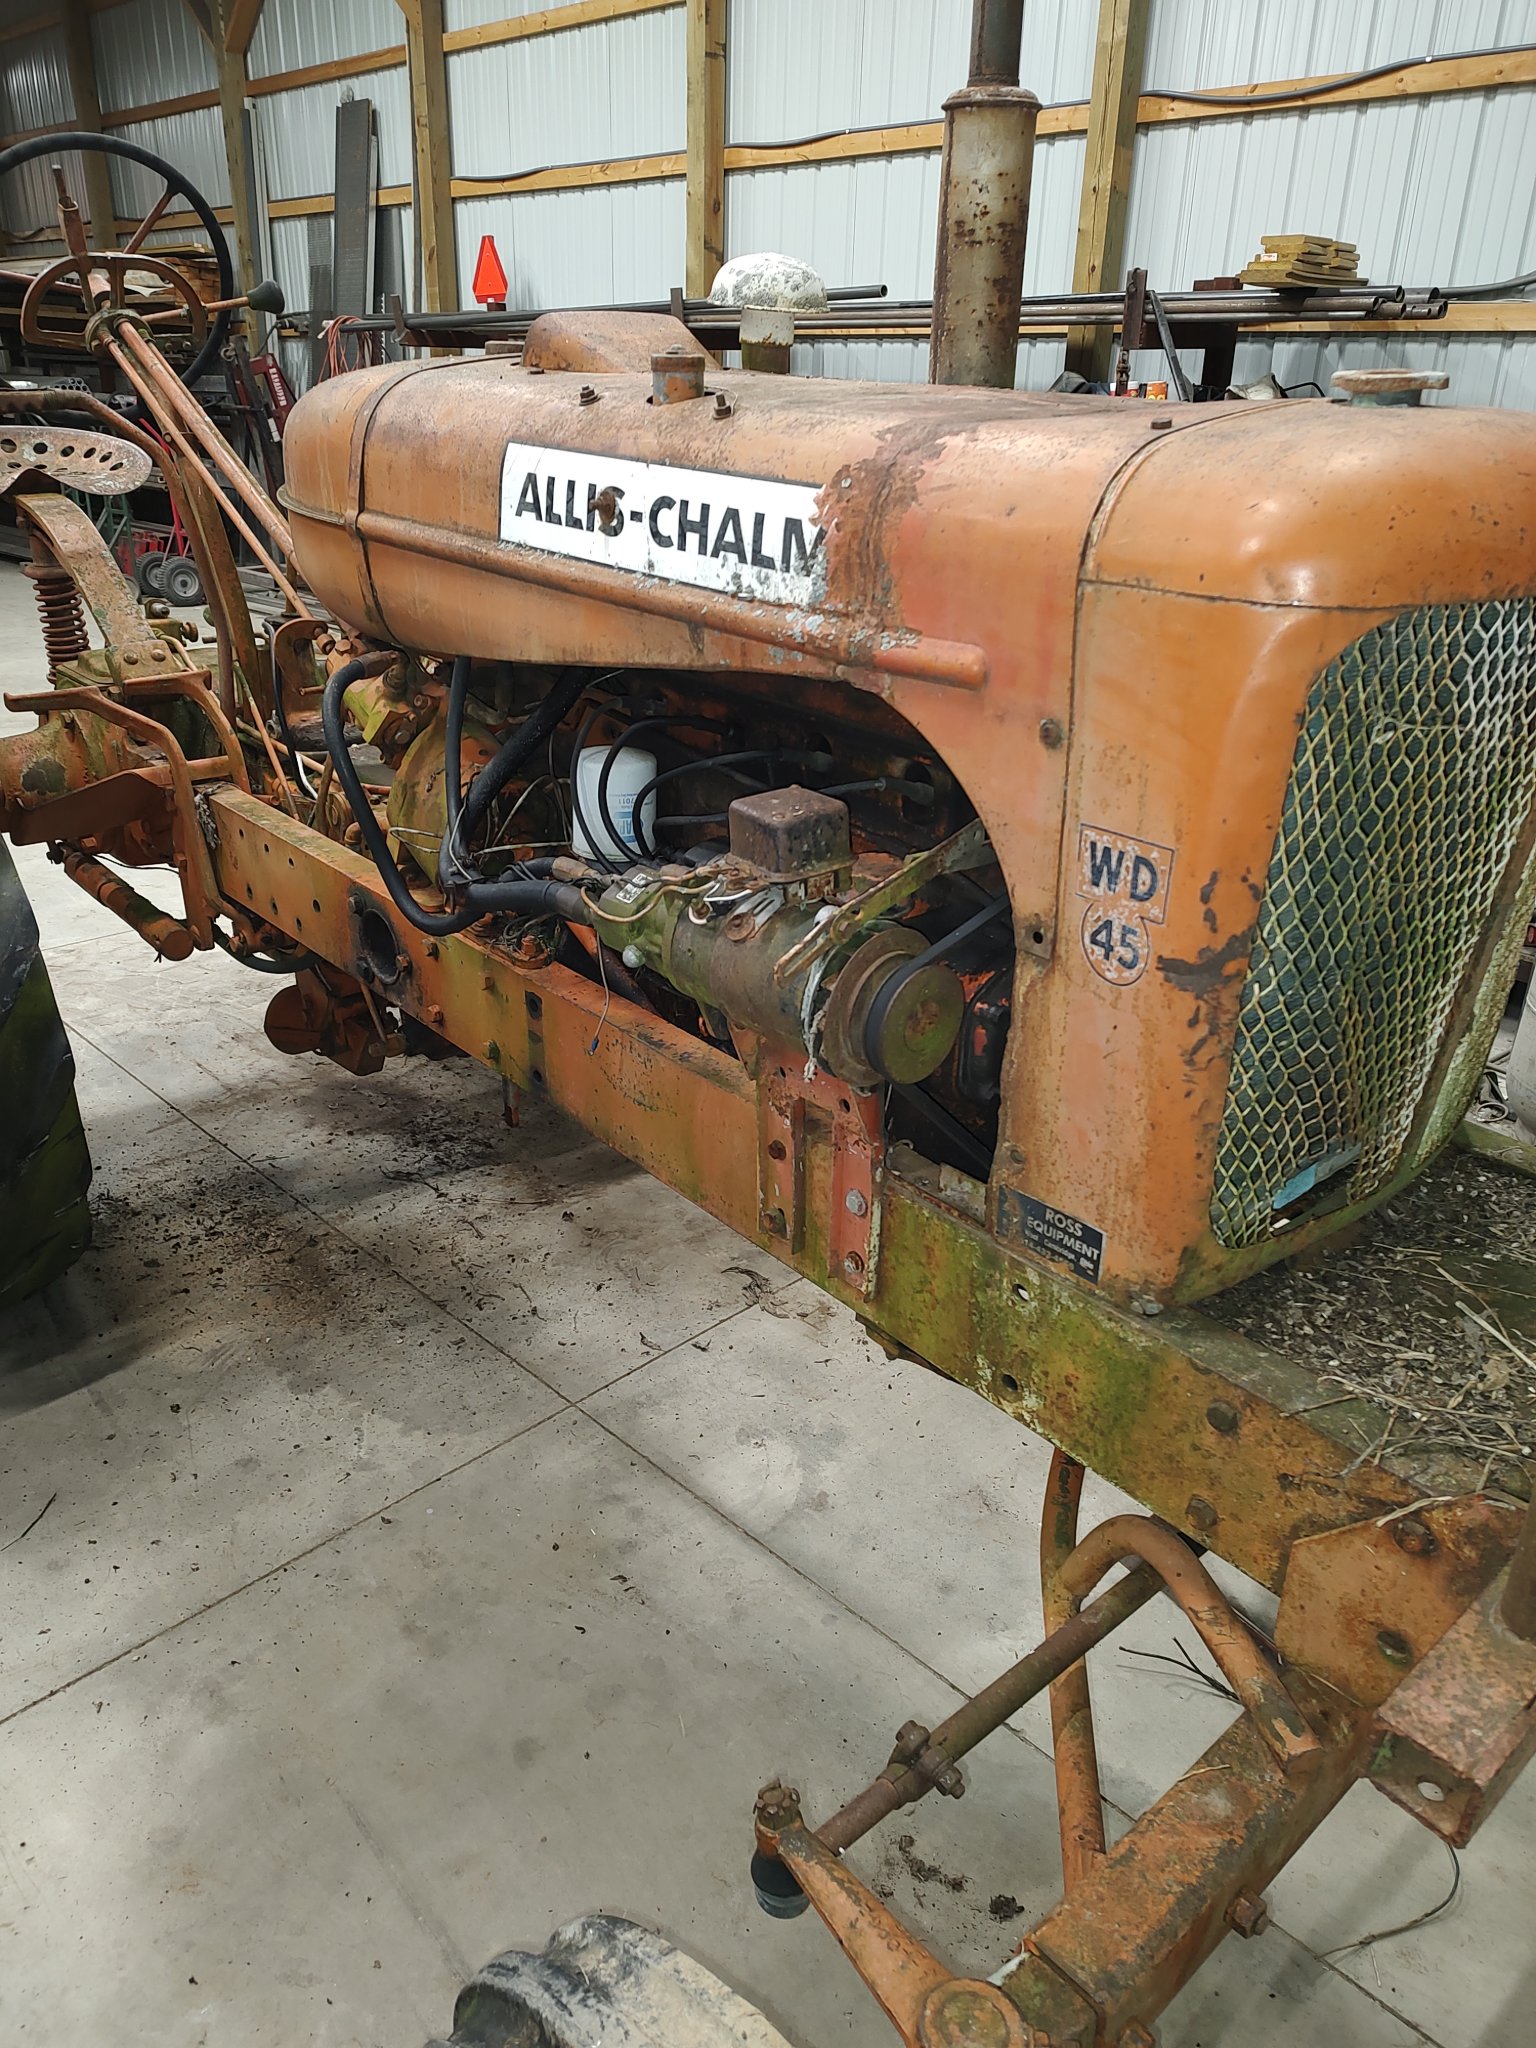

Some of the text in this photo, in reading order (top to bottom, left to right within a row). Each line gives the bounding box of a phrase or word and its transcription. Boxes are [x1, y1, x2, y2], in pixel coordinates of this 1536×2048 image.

[1089, 841, 1158, 902] WD
[1089, 919, 1140, 970] 45
[1026, 1216, 1100, 1260] EQUIPMENT
[1045, 1208, 1083, 1237] ROSS
